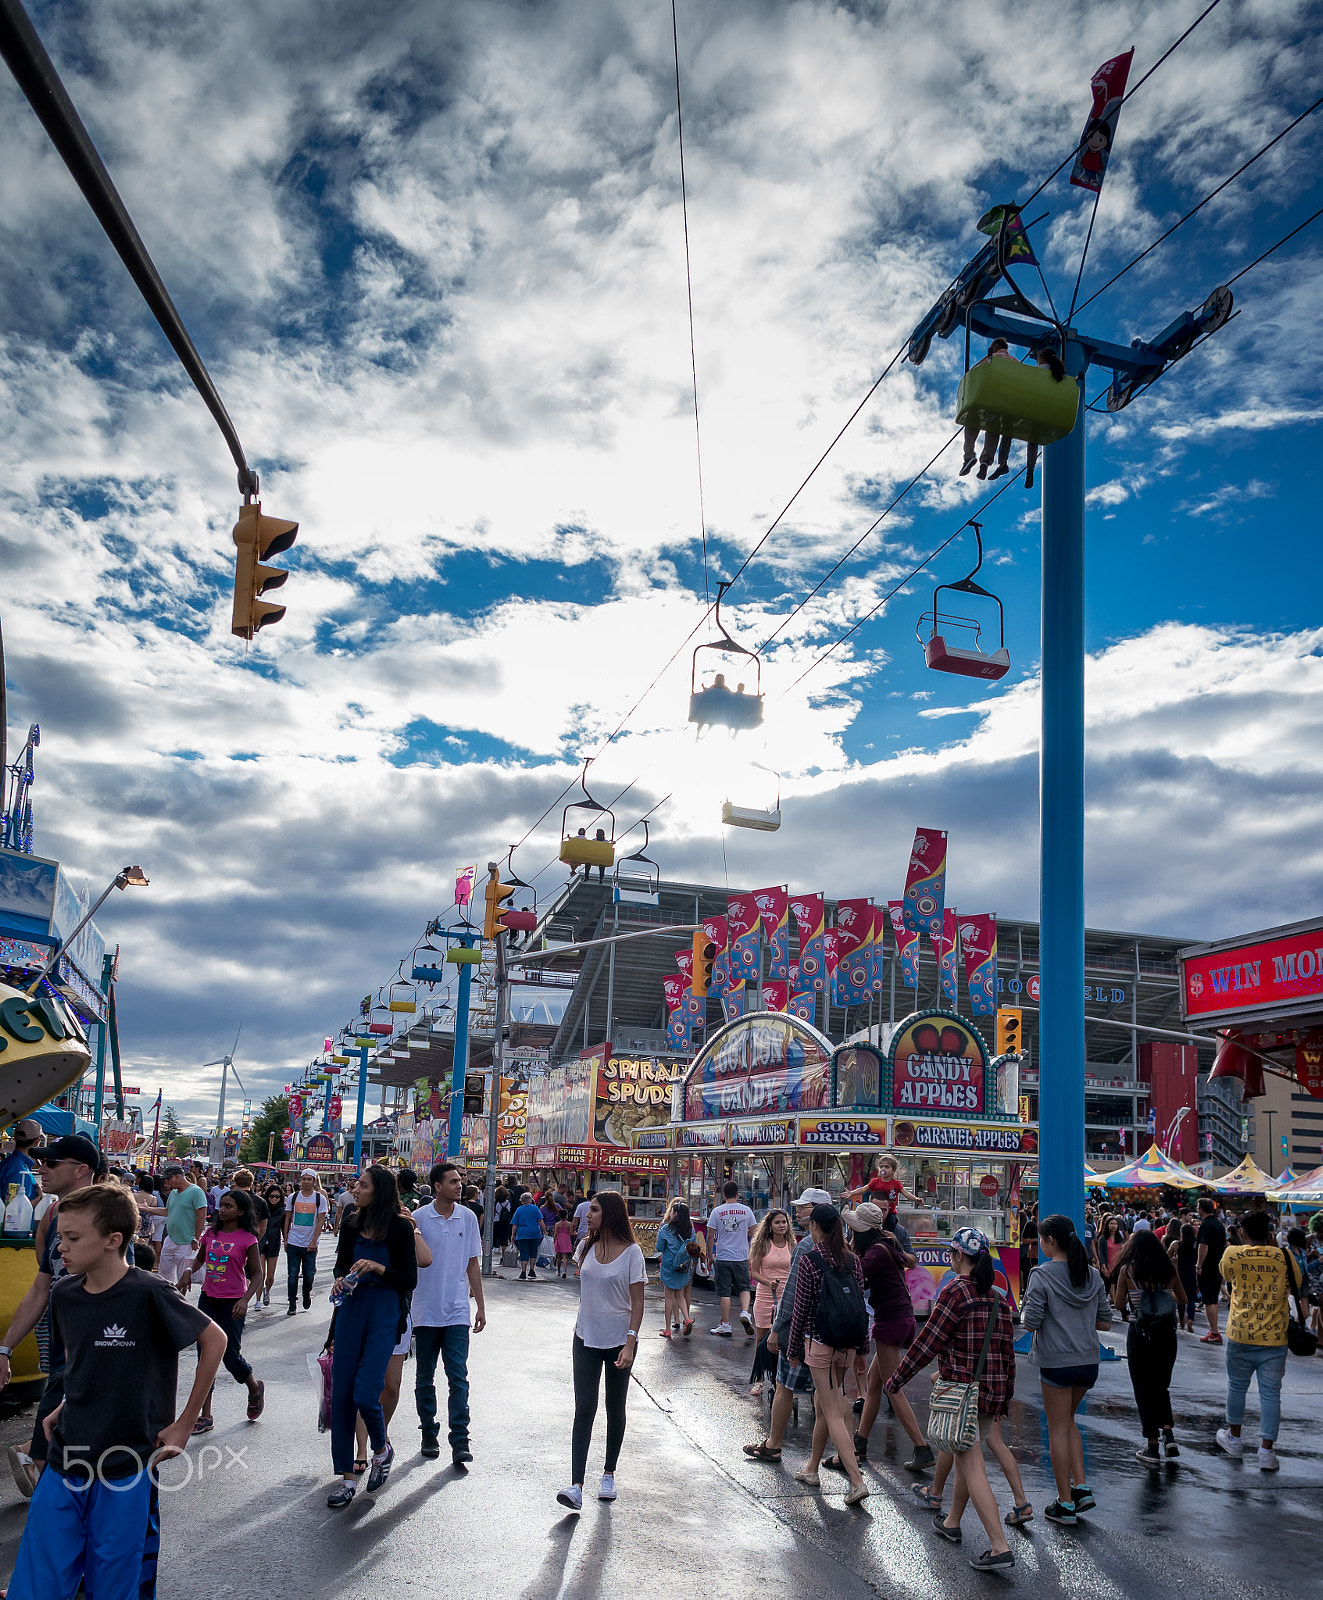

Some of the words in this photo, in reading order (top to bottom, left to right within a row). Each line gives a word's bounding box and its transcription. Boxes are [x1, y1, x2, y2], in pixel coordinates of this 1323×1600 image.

[1209, 960, 1262, 993] WIN
[719, 1026, 784, 1073] COTTON
[604, 1059, 679, 1082] SPIRAL
[907, 1053, 973, 1081] CANDY
[608, 1081, 673, 1105] SPUDS
[720, 1077, 777, 1111] CANDY
[900, 1081, 978, 1109] APPLES
[806, 1132, 880, 1143] DRINKS
[816, 1122, 868, 1132] COLD
[916, 1126, 973, 1146] CARAMEL
[975, 1130, 1019, 1149] APPLES
[560, 1155, 585, 1163] SPUDS
[608, 1156, 650, 1166] FRENCH
[1241, 1263, 1278, 1273] MAMBA
[1242, 1291, 1277, 1300] KOBE
